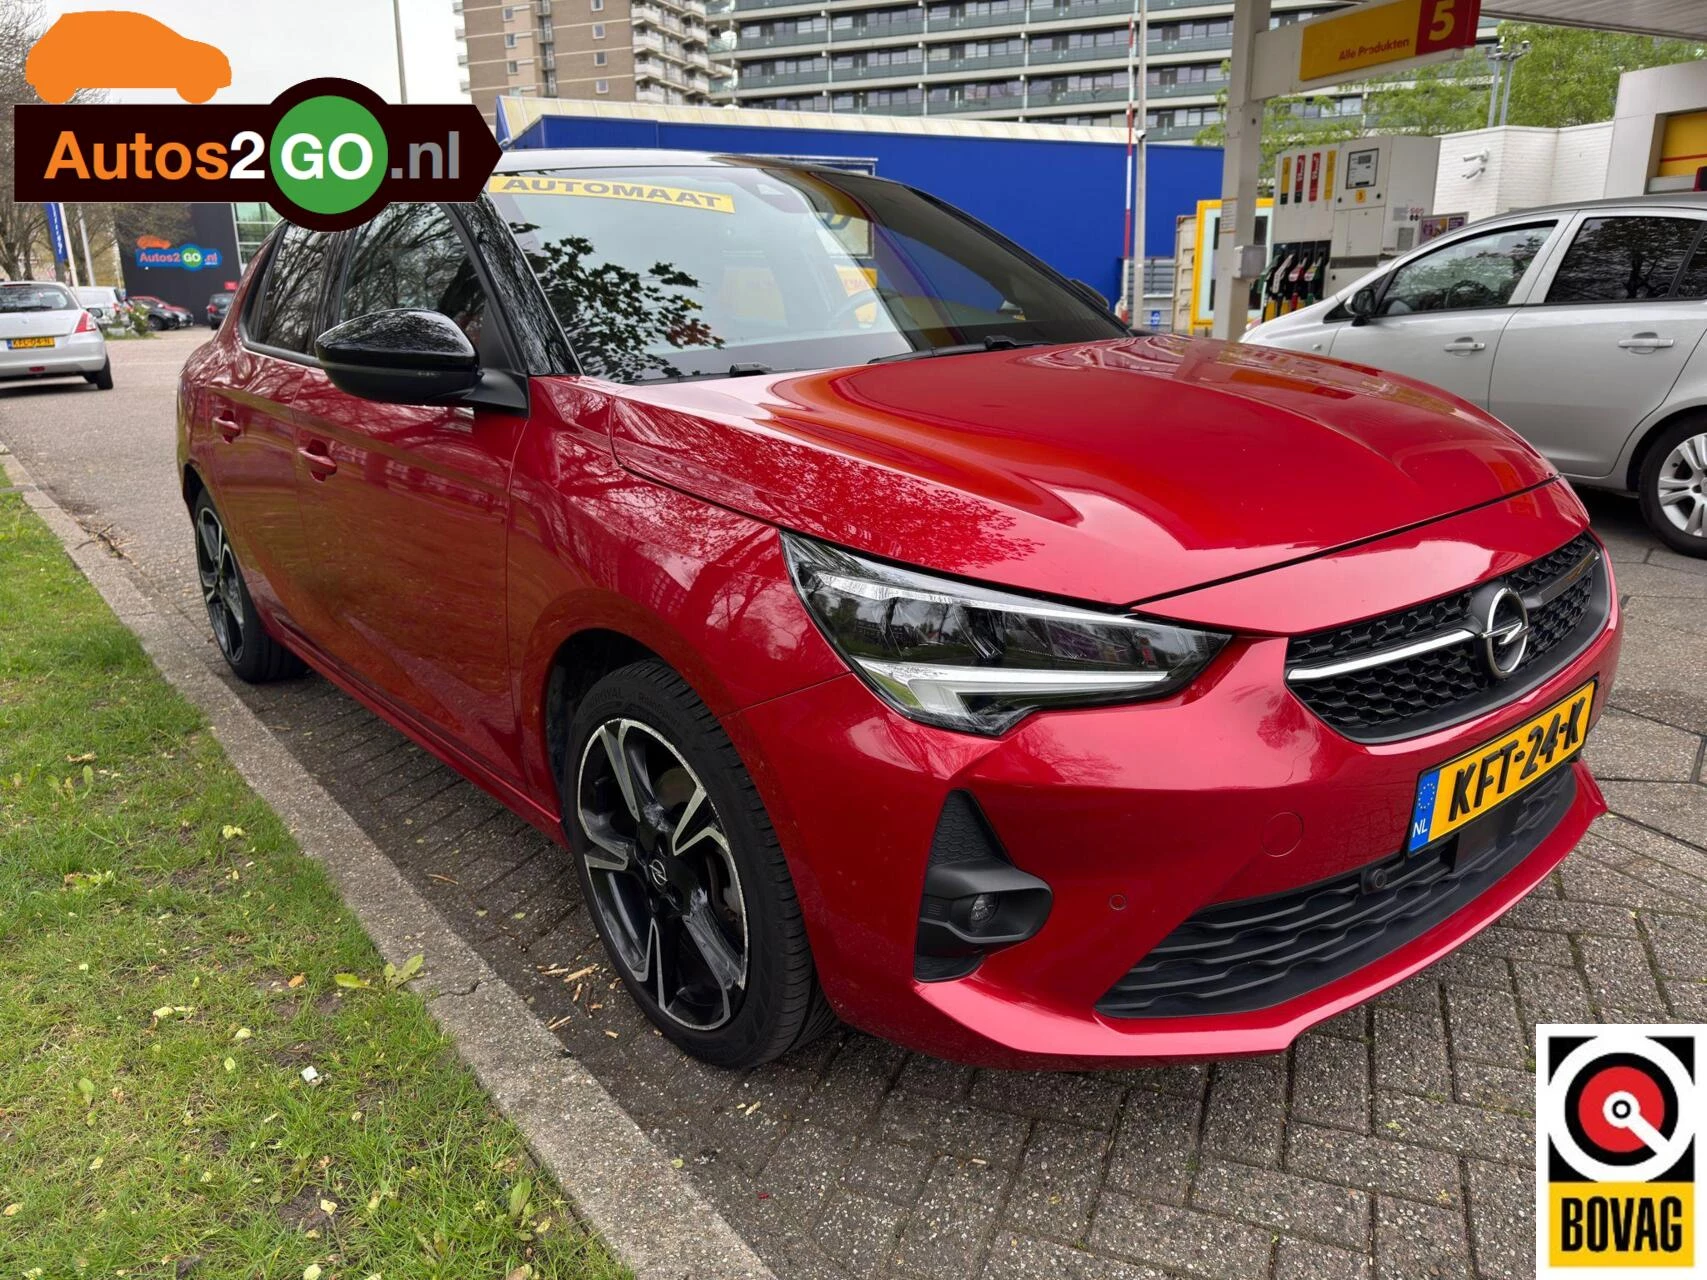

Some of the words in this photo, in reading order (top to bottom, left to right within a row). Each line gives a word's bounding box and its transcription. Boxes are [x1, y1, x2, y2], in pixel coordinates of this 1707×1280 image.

[1428, 0, 1456, 41] 5
[1338, 49, 1356, 61] Alle
[1358, 38, 1409, 57] Produkten
[503, 179, 721, 208] AUTOMAAT
[1448, 696, 1586, 822] KFT-24-K
[1412, 818, 1428, 838] NL
